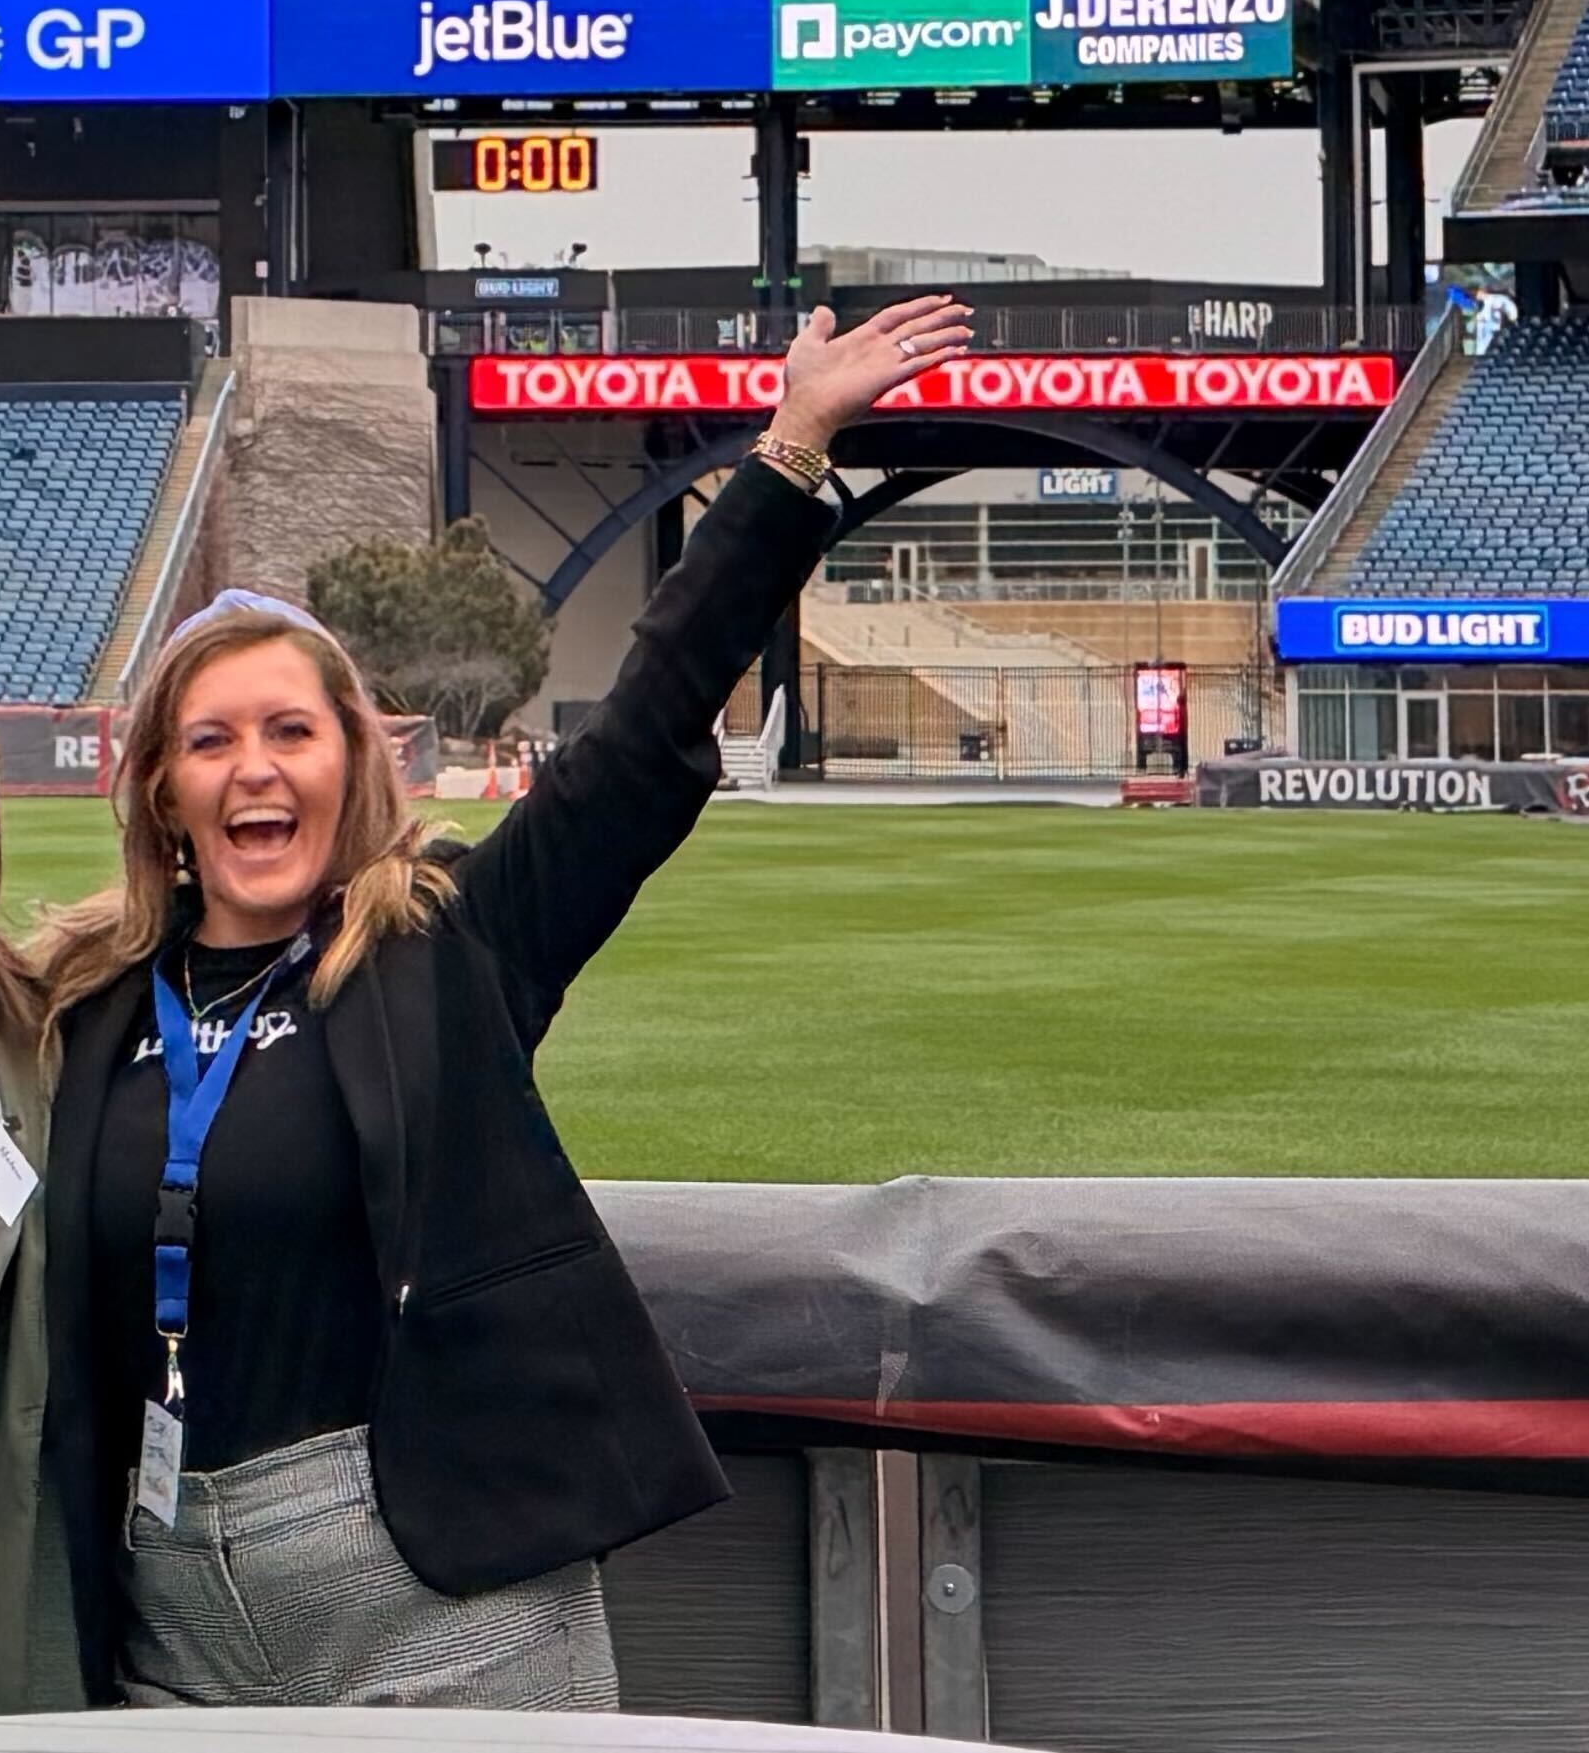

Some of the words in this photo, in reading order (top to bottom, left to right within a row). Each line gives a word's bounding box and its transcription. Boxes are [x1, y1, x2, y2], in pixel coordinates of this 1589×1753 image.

[413, 0, 628, 76] jetBlue
[843, 21, 1015, 56] paycom
[1077, 33, 1244, 65] COMPANIES
[476, 138, 590, 191] 0:00
[1204, 300, 1273, 339] HARP
[497, 363, 698, 404] TOYOTA
[720, 363, 924, 405] TOA
[940, 359, 1147, 404] TOYOTA
[1166, 359, 1375, 404] TOYOTA
[1043, 475, 1113, 494] LIGHT
[1340, 614, 1425, 646] BUD
[1427, 614, 1542, 646] LIGHT
[1259, 768, 1492, 803] REVOLUTION
